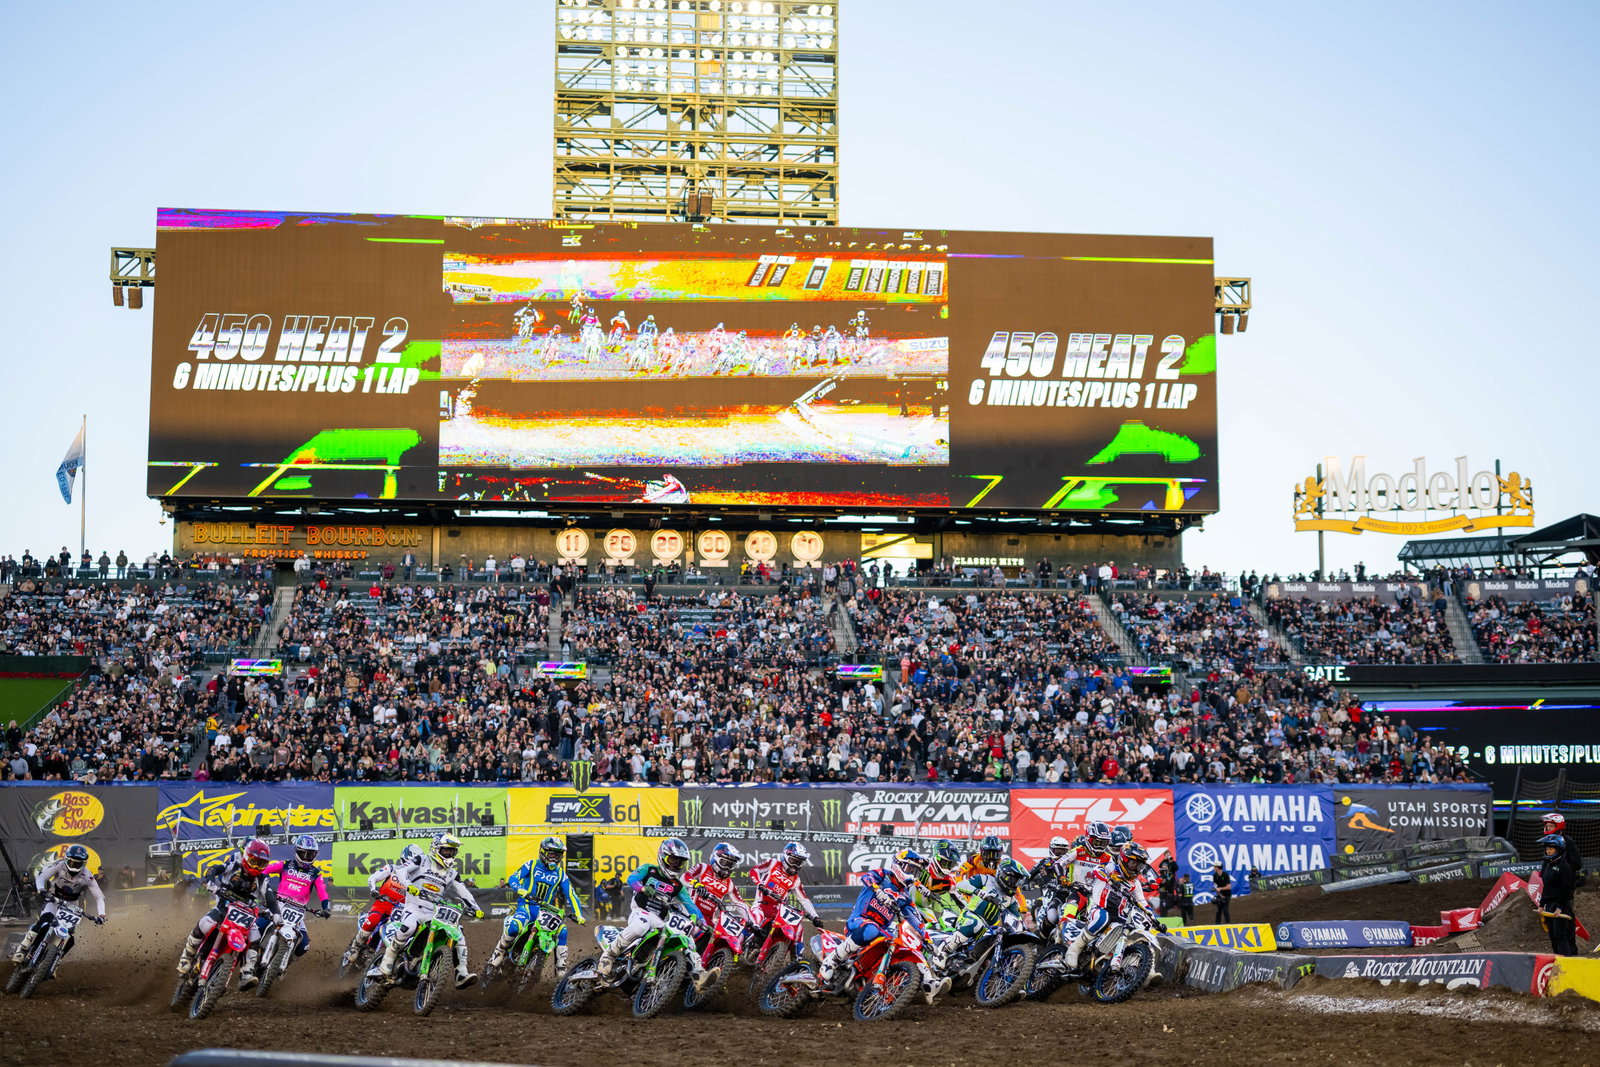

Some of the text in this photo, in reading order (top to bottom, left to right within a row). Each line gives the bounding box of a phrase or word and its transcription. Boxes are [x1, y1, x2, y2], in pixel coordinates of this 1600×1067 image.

[188, 313, 409, 363] 450 HEAT 2
[981, 331, 1185, 380] 450 HEAT 2
[172, 362, 420, 394] 6 MINUTES/PLUS 1 LAP
[969, 379, 1198, 410] 6 MINUTES/PLUS 1 LAP
[1324, 455, 1499, 512] Modelo
[193, 524, 419, 547] BULLEIT BOURBON
[1401, 523, 1426, 533] 1925
[314, 550, 367, 559] WHISKEY
[954, 557, 1024, 566] CLASSIC HITS
[1284, 583, 1307, 592] Modelo
[1318, 583, 1341, 592] Modelo
[1352, 584, 1375, 592] Modelo
[1485, 582, 1508, 590] Modelo
[1515, 581, 1539, 590] Modelo
[1545, 580, 1569, 589] Modelo
[1485, 745, 1496, 764] 6
[62, 793, 90, 807] Bass
[872, 790, 1009, 805] ROCKY MOUNTAIN
[62, 806, 83, 818] Pro
[350, 801, 492, 824] Kawasaki
[551, 798, 604, 817] SMX
[712, 800, 811, 818] MONSTER
[1217, 795, 1324, 822] YAMAHA
[1388, 802, 1487, 814] UTAH SPORTS
[61, 817, 96, 832] Shops
[206, 803, 334, 832] alpinestars
[1389, 816, 1486, 828] COMMISSION
[1219, 844, 1325, 871] YAMAHA
[534, 870, 558, 883] FXR
[771, 870, 793, 887] FXR
[1269, 874, 1312, 885] MONSTER
[1430, 869, 1464, 882] MONSTER
[646, 877, 674, 893] FCP
[702, 876, 728, 893] FXR
[57, 911, 80, 925] 344
[227, 909, 256, 928] 874
[282, 908, 304, 924] 667
[436, 907, 460, 924] 519
[538, 913, 560, 931] 36
[782, 909, 800, 923] 17
[1133, 913, 1152, 931] 24
[723, 917, 741, 935] 12
[1312, 928, 1348, 940] YAMAHA
[1372, 928, 1407, 940] YAMAHA
[1361, 959, 1407, 977] ROCKY
[1405, 958, 1485, 976] MOUNTAIN
